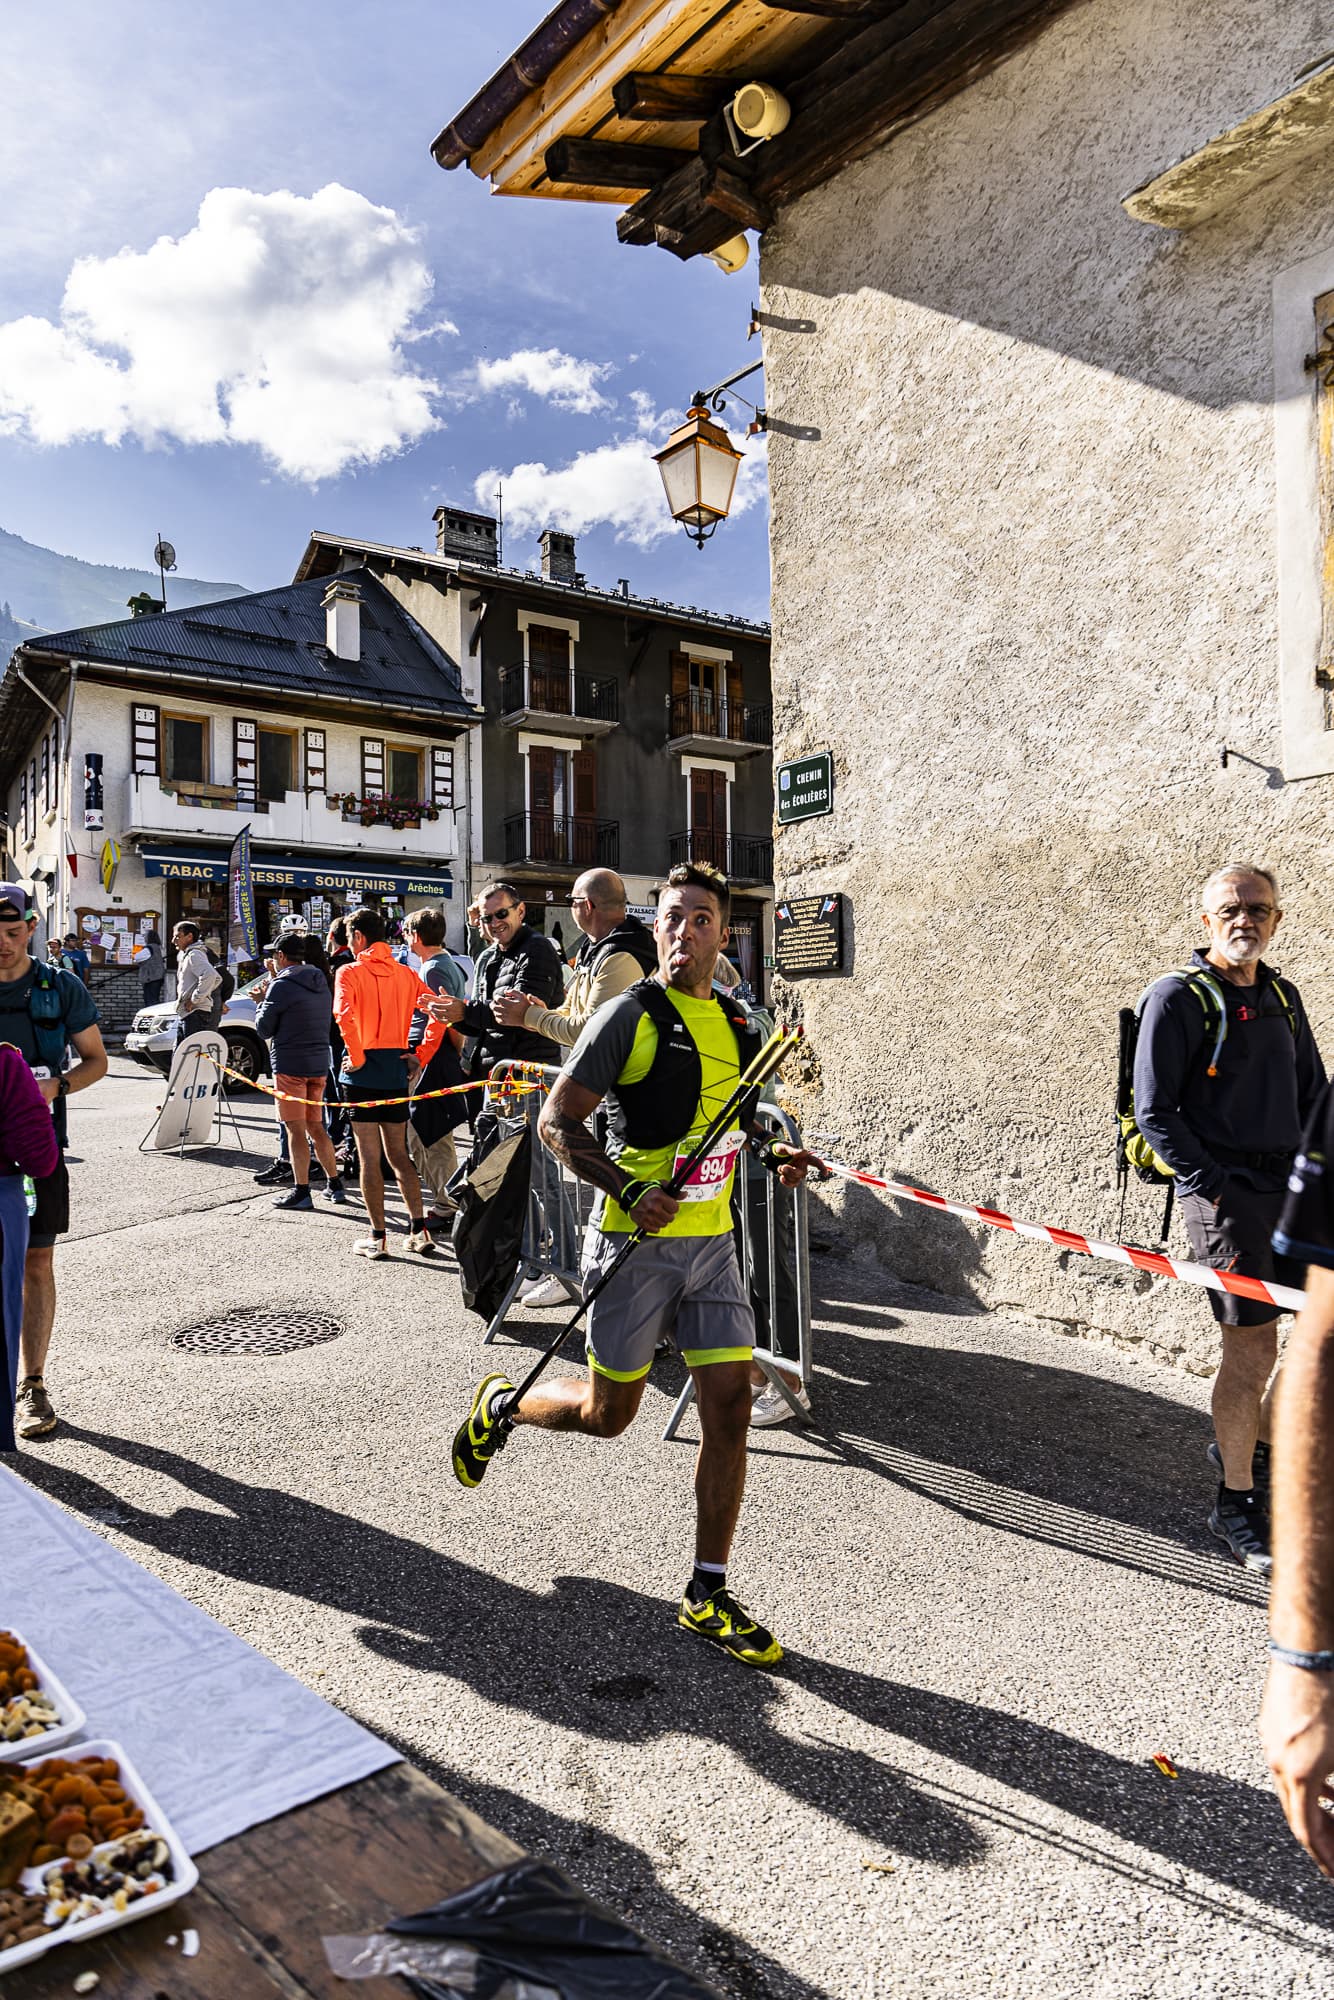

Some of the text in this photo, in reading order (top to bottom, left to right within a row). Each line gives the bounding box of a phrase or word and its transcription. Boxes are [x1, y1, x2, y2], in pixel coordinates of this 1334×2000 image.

[796, 768, 822, 785] CHEMIN
[792, 788, 828, 807] ÉCOLIÈRES
[160, 864, 214, 878] TABAC
[250, 871, 295, 884] RESSE
[314, 875, 397, 891] SOUVENIRS
[407, 882, 444, 895] Arêches
[629, 907, 656, 915] D'ALSACE
[183, 1084, 208, 1100] CB
[700, 1157, 727, 1182] 994
